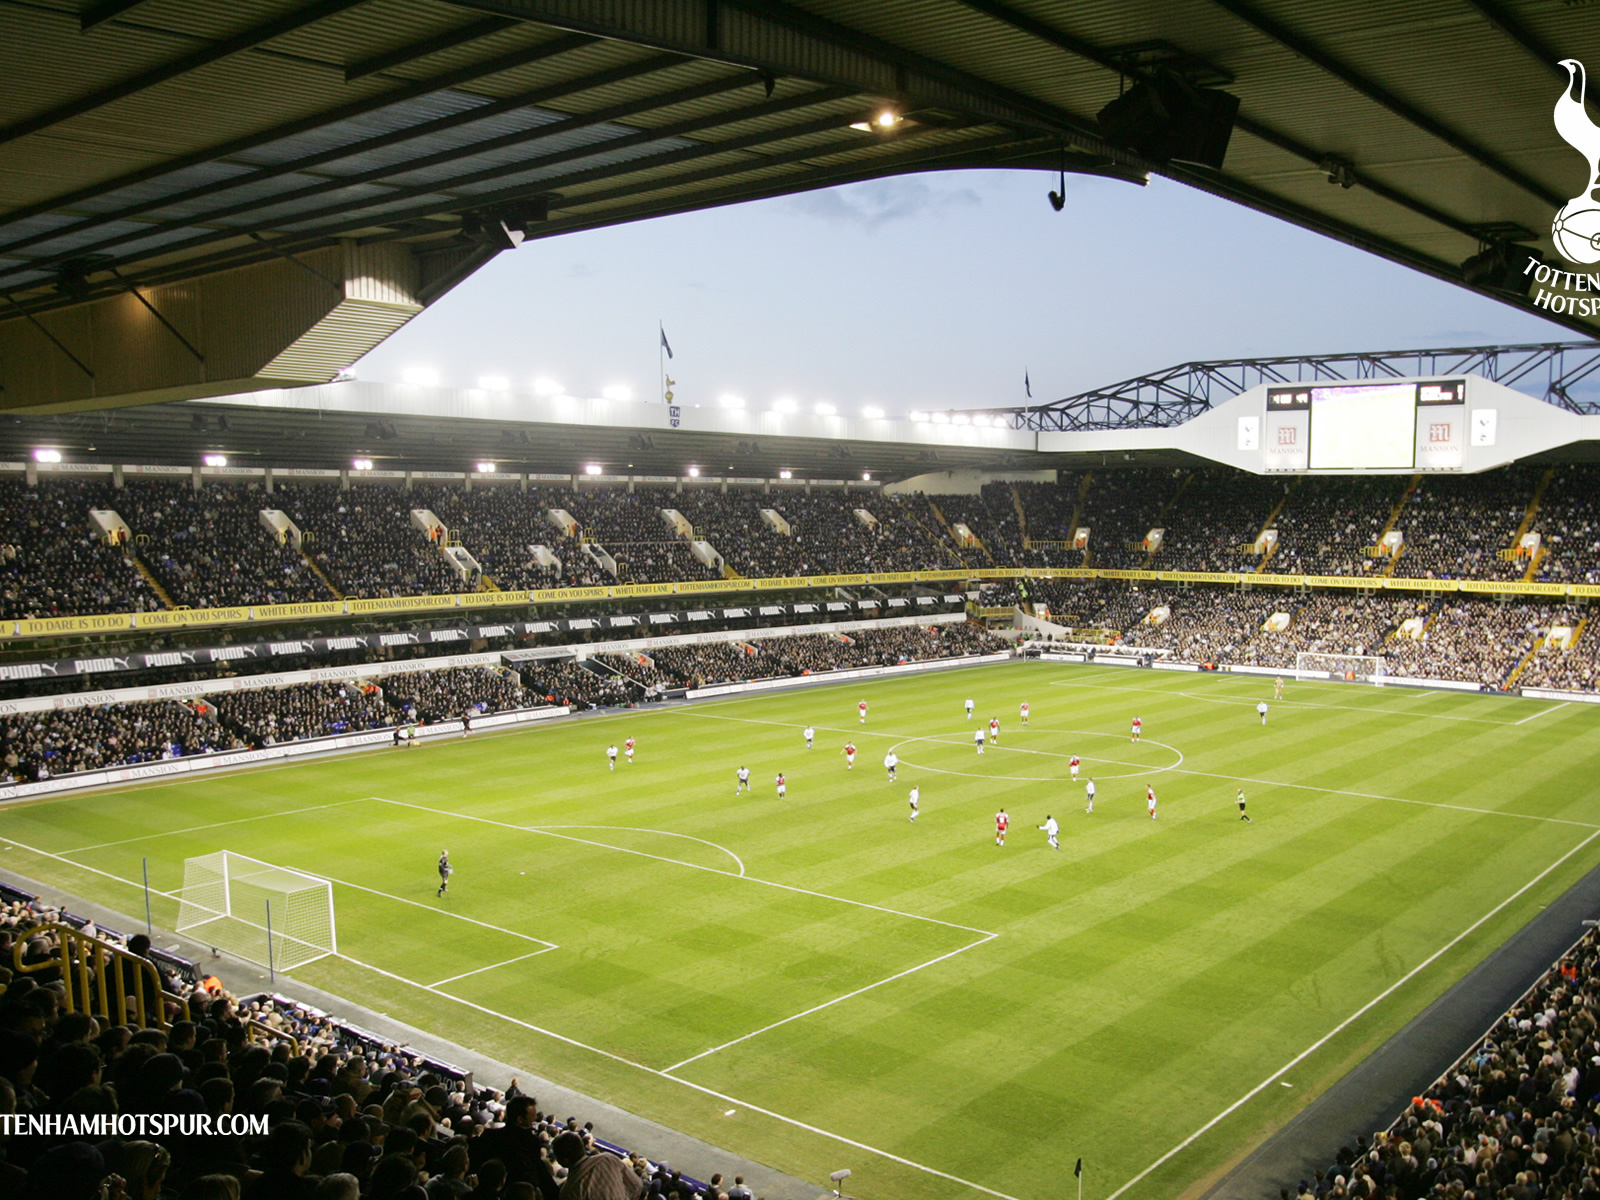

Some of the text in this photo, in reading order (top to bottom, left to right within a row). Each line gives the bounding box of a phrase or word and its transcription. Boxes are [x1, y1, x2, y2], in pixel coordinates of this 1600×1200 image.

[538, 588, 604, 600] COME ON YOU SPURS
[615, 585, 669, 596] WHITE HART LANE
[353, 597, 451, 611] TOTTENHAMHOTSPUR.COM
[465, 592, 526, 604] TO DARE IS TO DO
[259, 602, 337, 617] WHITE HART LANE
[142, 608, 242, 625] COME ON YOU SPURS
[29, 616, 124, 633] TO DARE IS TO DO
[525, 622, 550, 634] PUMA
[430, 629, 458, 642] PUMA
[479, 626, 506, 638] PUMA
[327, 637, 357, 650] PUMA
[380, 633, 409, 646] PUMA
[210, 646, 245, 662] PUMA
[270, 641, 303, 656] PUMA
[74, 658, 116, 674] PUMA
[144, 652, 182, 668] PUMA
[456, 655, 490, 666] MANSION
[0, 664, 42, 681] PUMA
[390, 662, 426, 673] MANSION
[318, 669, 358, 680] MANSION
[243, 676, 284, 688] MANSION
[158, 684, 204, 699] MANSION
[64, 693, 116, 708] MANSION
[222, 752, 266, 765] MANSION
[130, 764, 179, 779] MANSION
